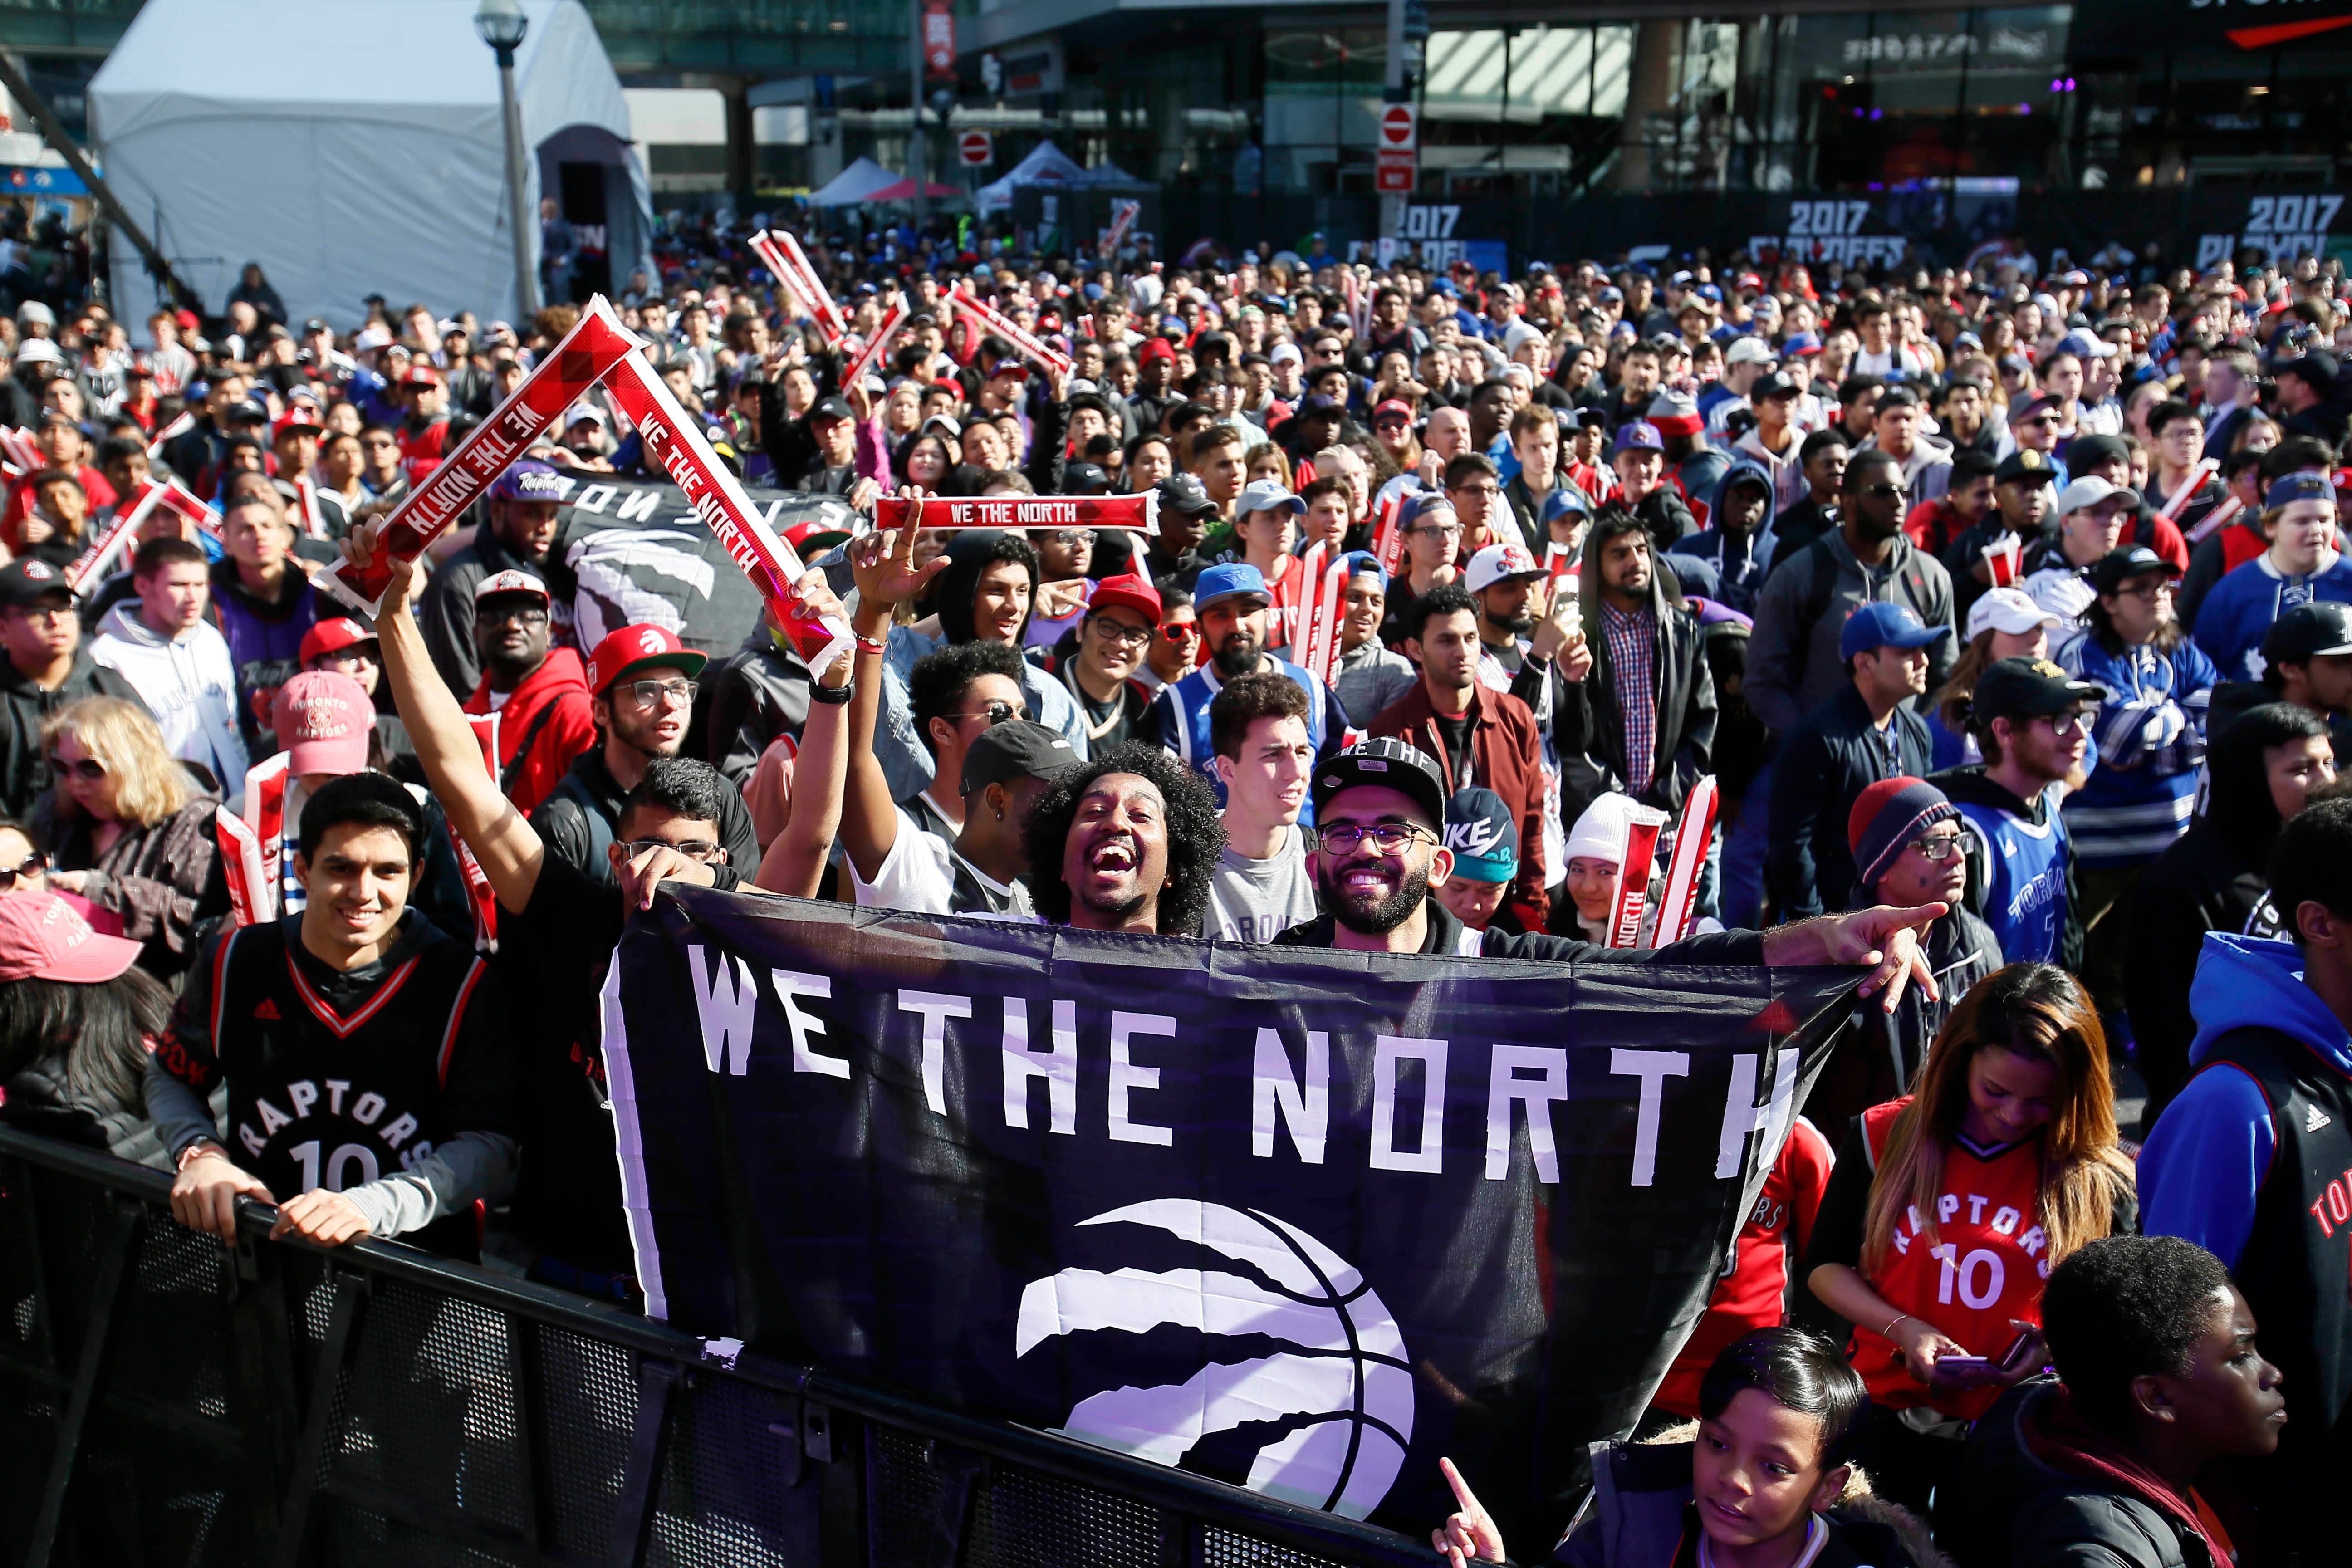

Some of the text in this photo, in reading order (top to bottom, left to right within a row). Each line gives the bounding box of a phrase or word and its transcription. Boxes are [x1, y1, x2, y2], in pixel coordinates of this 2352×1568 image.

[1788, 200, 1870, 235] 2017
[2247, 195, 2345, 232] 2017
[405, 401, 544, 536] WE THE NORTH
[639, 411, 760, 576] WE THE NORTH
[951, 503, 1076, 523] WE THE NORTH
[292, 697, 349, 711] TORONTO
[296, 724, 347, 739] RAPTORS
[1380, 736, 1431, 770] THE
[1441, 817, 1491, 849] IKE
[1618, 891, 1645, 946] NORTH
[686, 944, 1801, 1185] WE THE NORTH
[239, 1079, 432, 1171] RAPTORS
[2306, 1115, 2332, 1132] adidas
[289, 1139, 379, 1196] 10
[1930, 1243, 2004, 1310] 10
